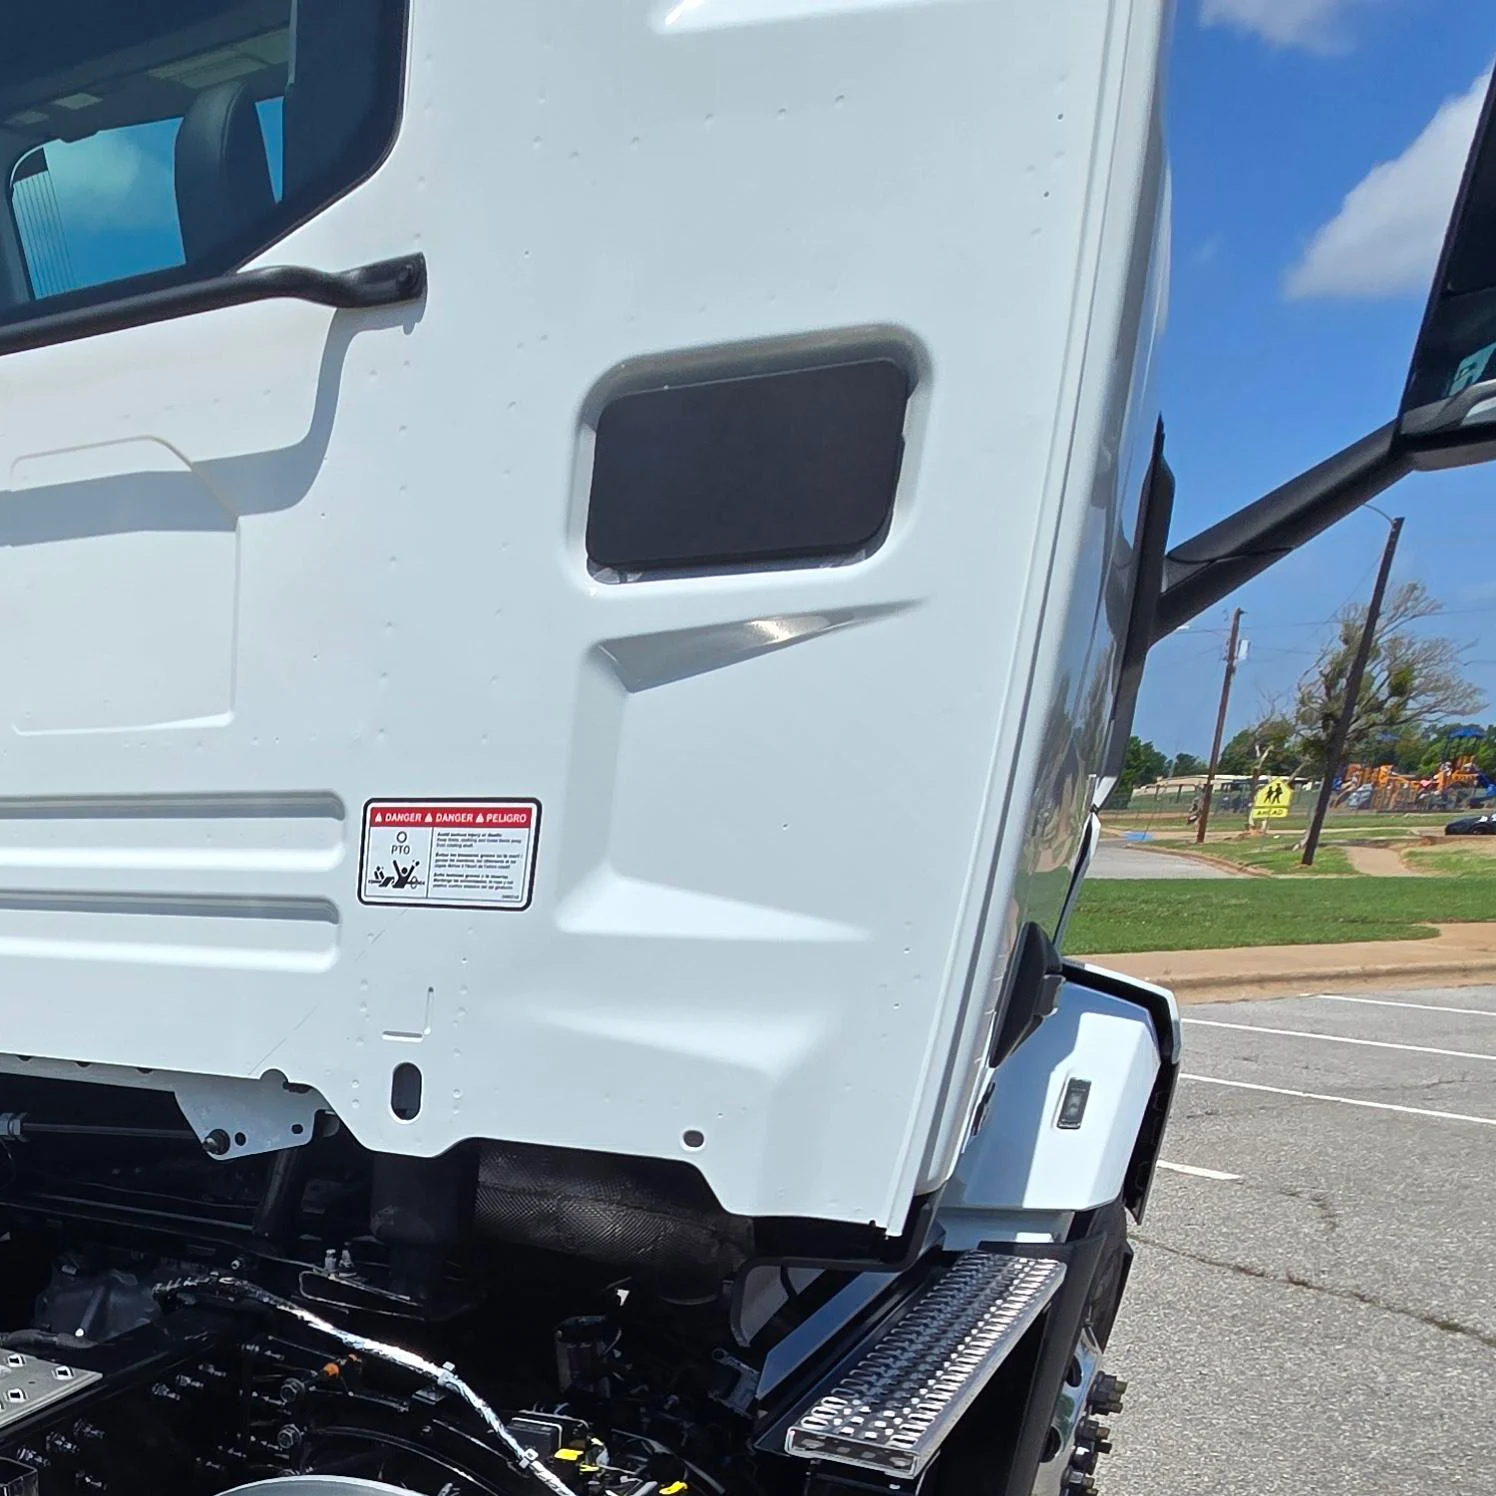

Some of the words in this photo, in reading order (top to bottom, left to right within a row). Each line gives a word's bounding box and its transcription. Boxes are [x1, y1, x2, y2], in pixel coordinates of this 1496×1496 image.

[384, 812, 422, 823] DANGER
[435, 812, 473, 823] DANGER
[485, 813, 527, 823] PELIGRO
[391, 845, 411, 855] PTO
